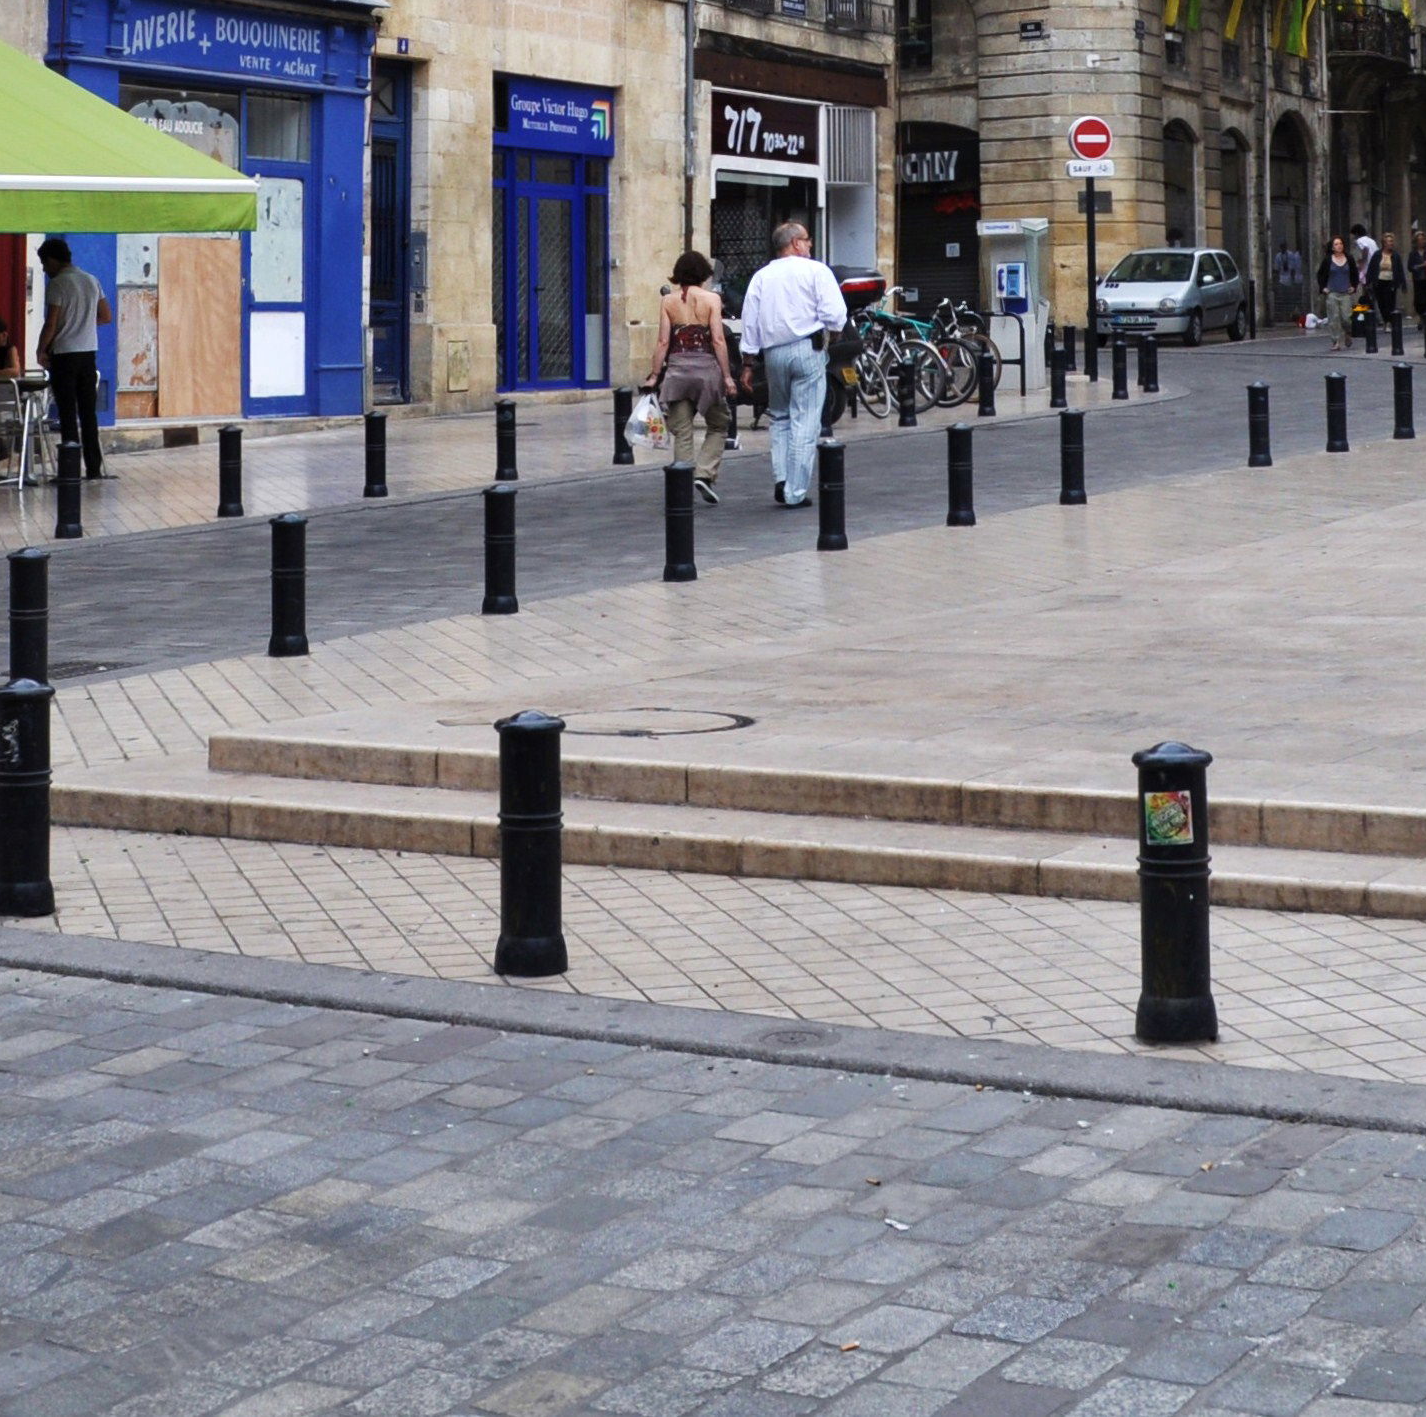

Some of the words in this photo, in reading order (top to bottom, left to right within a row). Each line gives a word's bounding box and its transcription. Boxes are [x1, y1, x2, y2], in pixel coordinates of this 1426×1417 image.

[123, 9, 196, 55] LAVERIE
[216, 17, 321, 54] BOUQUINERIE
[240, 55, 270, 71] VENTE
[511, 94, 541, 116] Groupe
[542, 97, 566, 116] Victor
[567, 101, 589, 122] Hugo
[724, 104, 762, 154] 7/7
